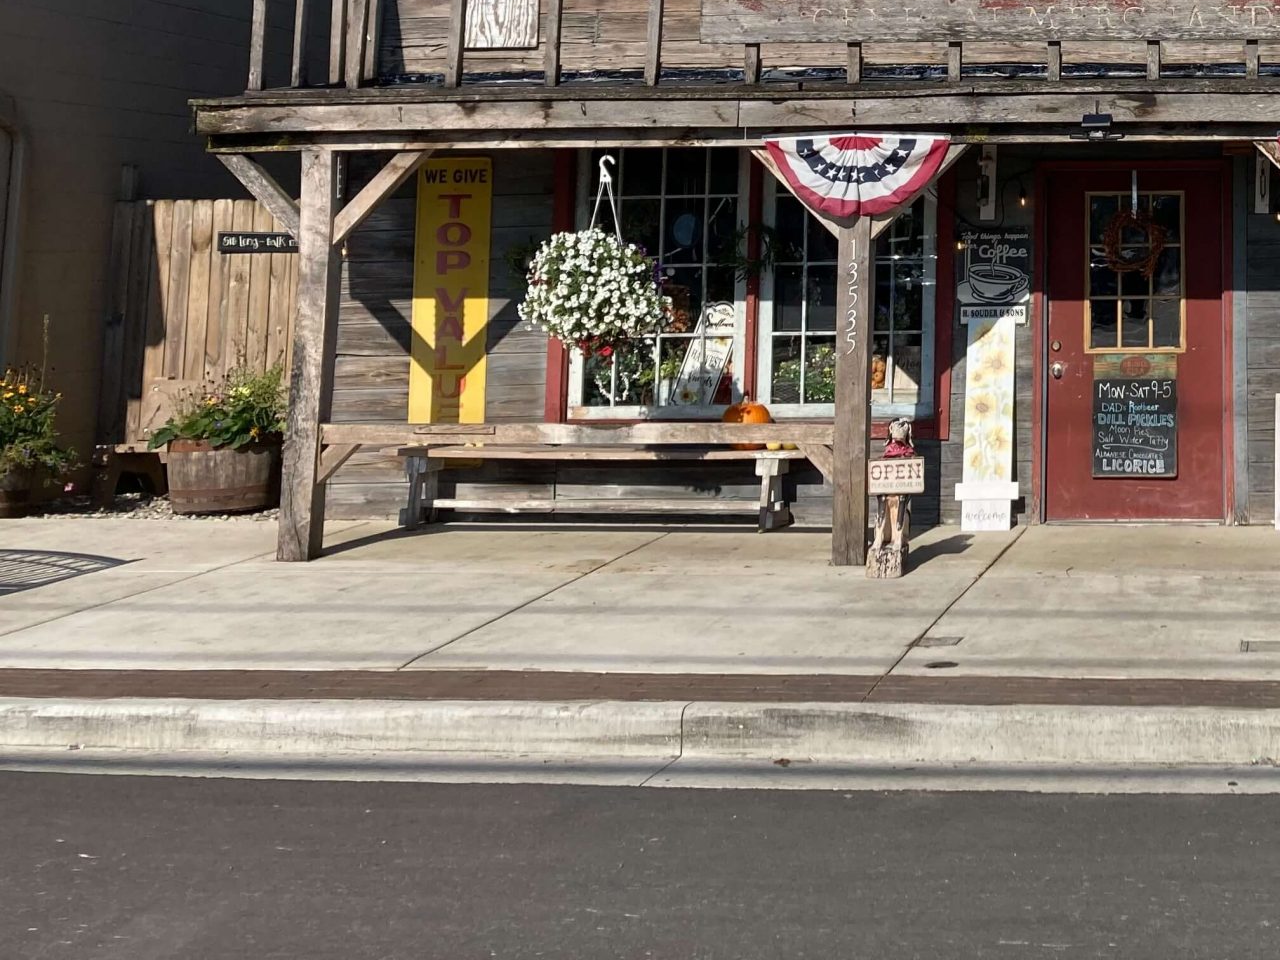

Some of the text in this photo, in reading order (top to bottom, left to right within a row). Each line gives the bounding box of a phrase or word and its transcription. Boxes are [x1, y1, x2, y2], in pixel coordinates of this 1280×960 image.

[425, 168, 488, 183] WE GIVE
[435, 193, 473, 276] TOP
[978, 243, 1029, 265] Coffee
[844, 237, 859, 356] 13535
[970, 309, 998, 319] SOUDER
[1006, 308, 1024, 317] SONS
[1151, 380, 1172, 399] 9-5
[1097, 413, 1175, 428] DILL PICKLES
[1098, 431, 1114, 443] Salt
[1119, 434, 1144, 445] Wter
[1109, 424, 1151, 438] Moon Pies
[870, 462, 922, 481] OPEN
[1102, 458, 1166, 474] LICORICE
